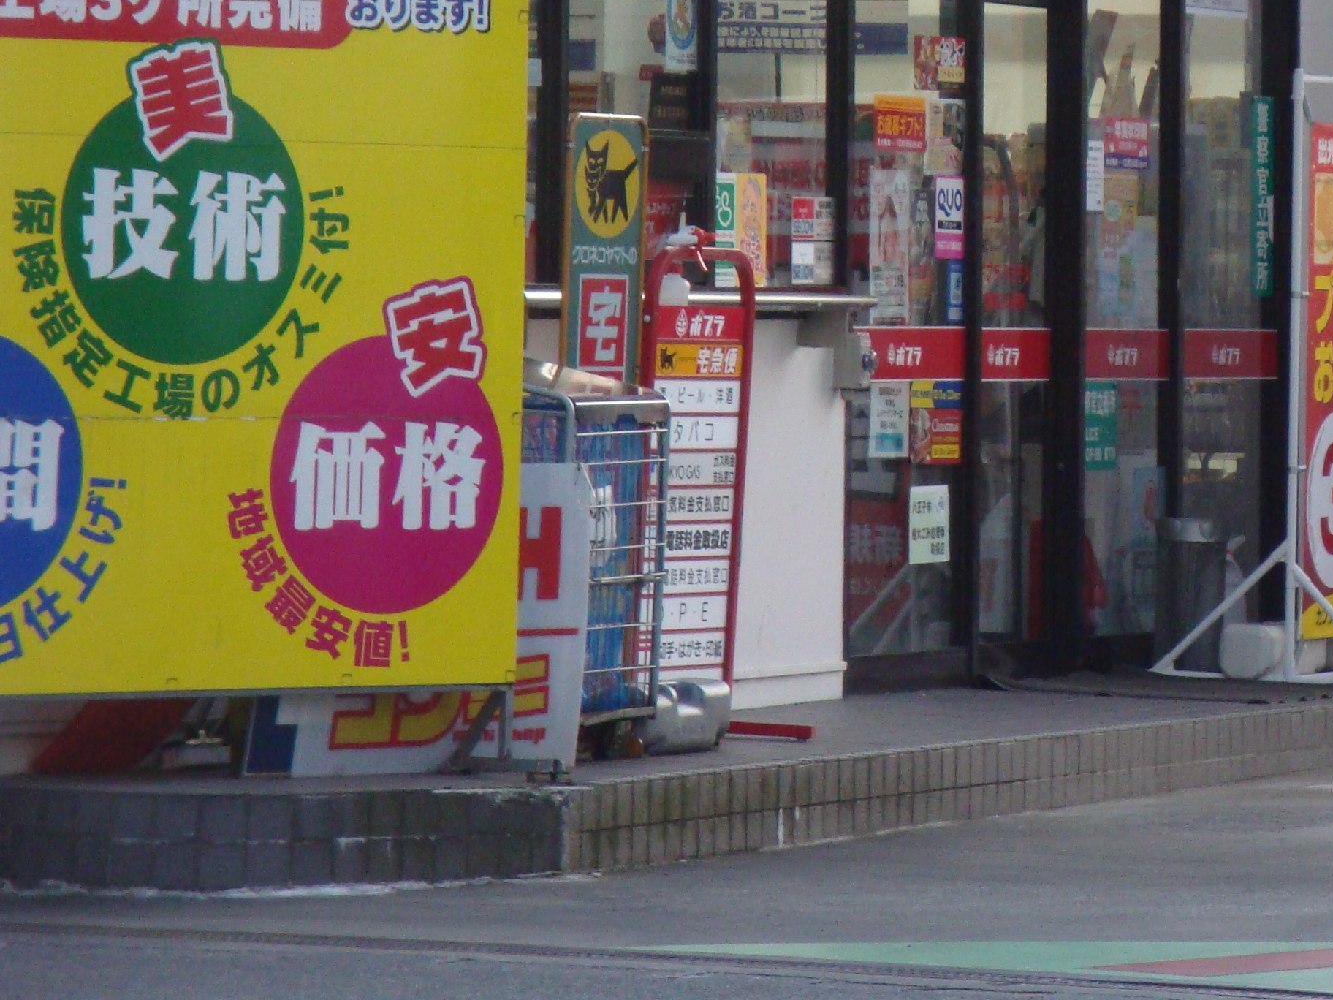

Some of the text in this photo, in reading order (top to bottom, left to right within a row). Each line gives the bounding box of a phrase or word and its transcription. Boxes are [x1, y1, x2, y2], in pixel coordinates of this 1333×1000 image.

[136, 49, 230, 152] 美
[937, 188, 963, 217] QUO
[81, 166, 286, 282] 技術
[571, 245, 638, 265] クロネコヤマトの
[690, 310, 726, 337] ポプラ
[393, 284, 477, 392] 安
[696, 346, 738, 374] 宅急便
[896, 343, 922, 366] ポプラ
[994, 344, 1020, 366] ポプラ
[673, 420, 714, 443] タバコ
[289, 421, 487, 531] 価格
[665, 529, 729, 551] 電話料金取扱店
[227, 486, 411, 669] 地域最安値!
